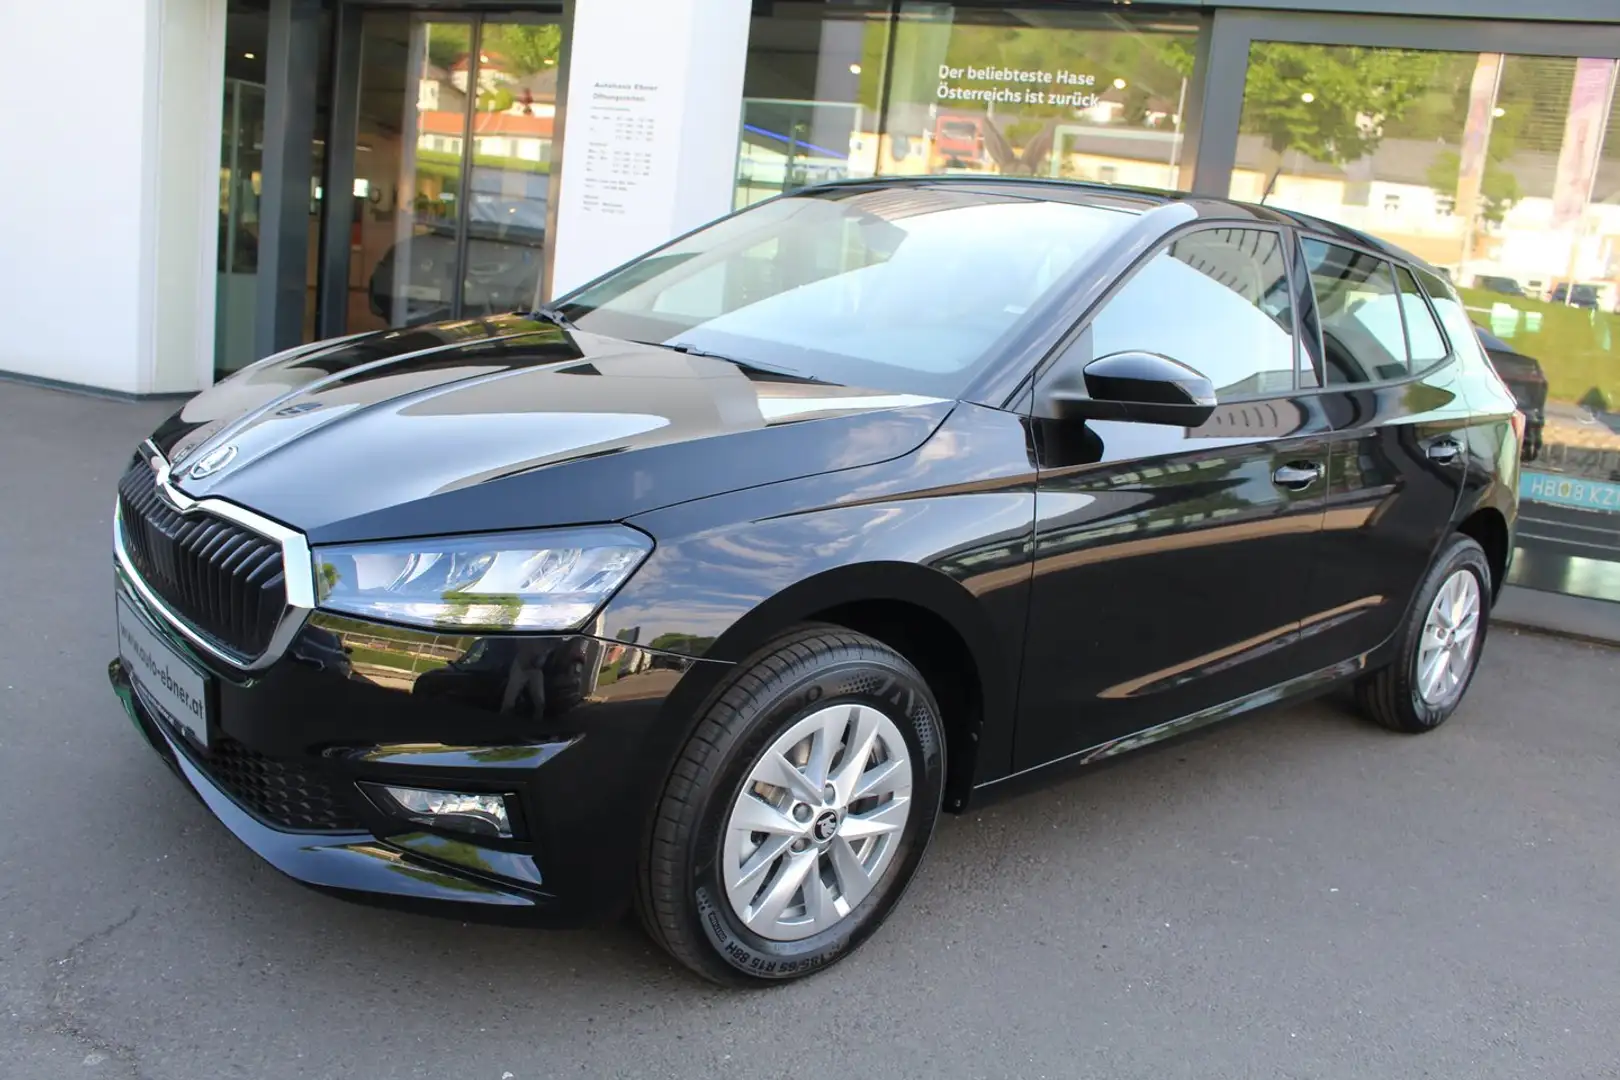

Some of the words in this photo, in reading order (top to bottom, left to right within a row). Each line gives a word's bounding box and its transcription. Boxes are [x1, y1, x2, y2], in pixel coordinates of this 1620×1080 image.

[938, 65, 964, 79] Der
[967, 65, 1053, 84] beliebteste
[1056, 69, 1095, 86] Hase
[936, 81, 1021, 103] Österreichs
[1025, 89, 1045, 104] ist
[120, 624, 204, 719] www.auto-ebner.at
[725, 942, 750, 964] 88H
[749, 957, 777, 973] R15
